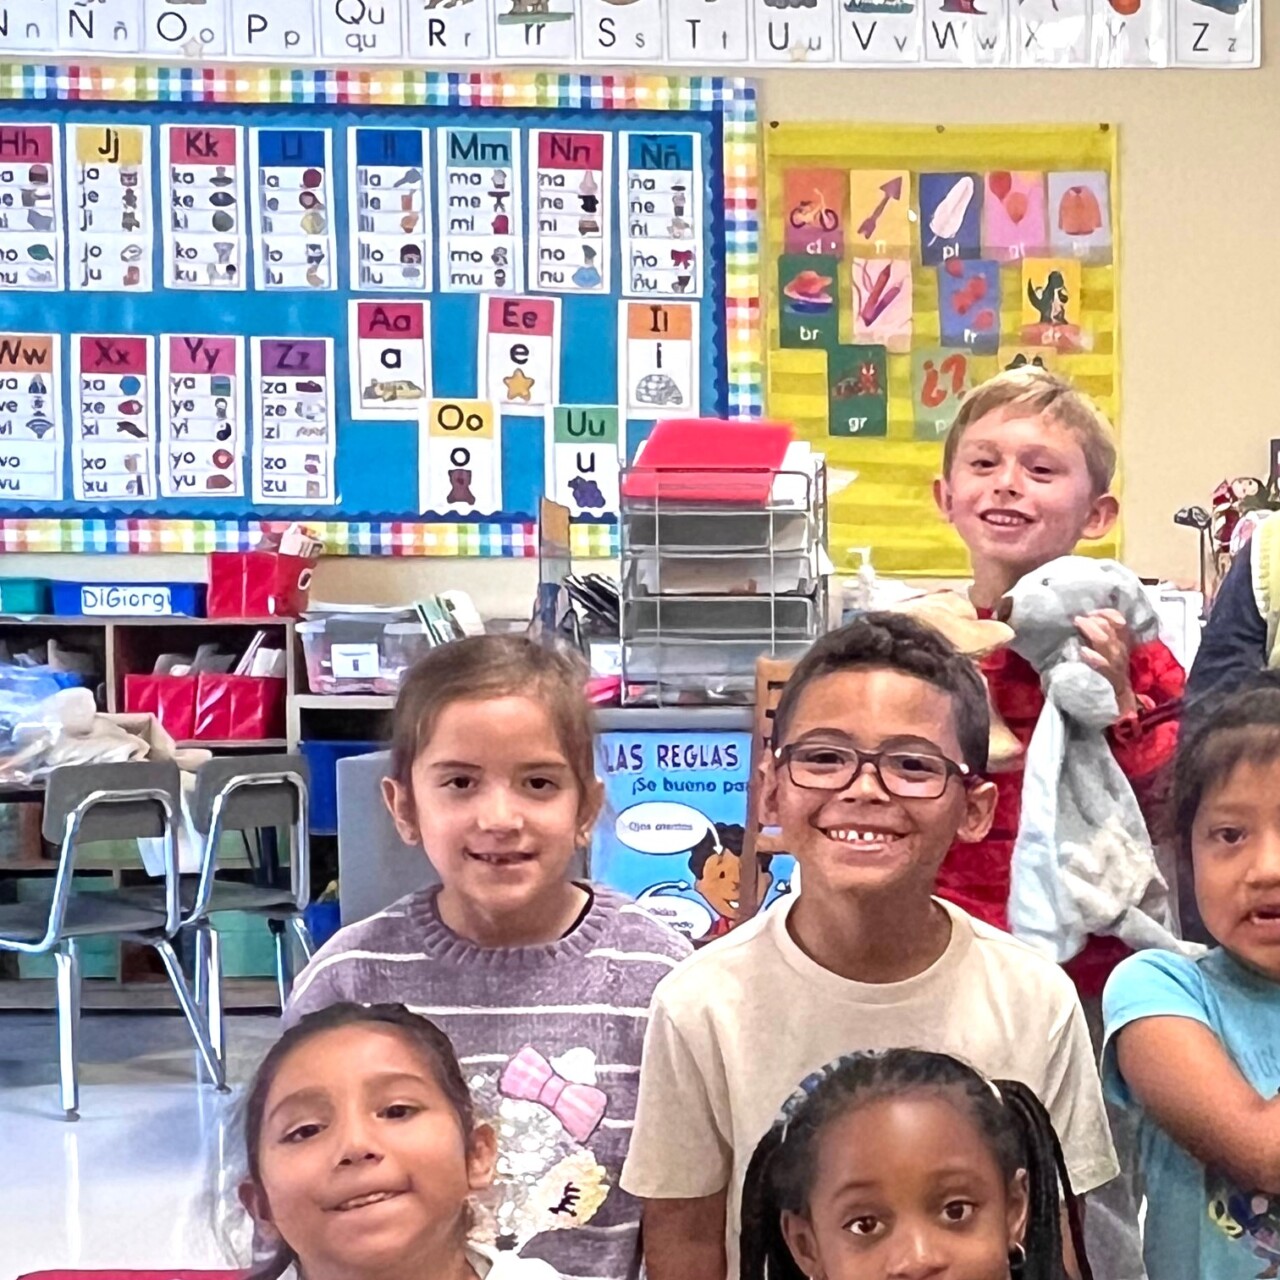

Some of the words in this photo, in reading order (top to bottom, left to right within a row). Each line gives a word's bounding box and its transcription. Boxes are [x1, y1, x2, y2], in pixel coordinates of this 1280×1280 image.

[69, 2, 93, 39] Ñ
[335, 0, 385, 25] Qu
[157, 12, 187, 41] O
[200, 28, 215, 43] o
[248, 14, 268, 43] P
[285, 31, 300, 48] p
[429, 19, 447, 47] R
[464, 33, 471, 47] r
[599, 18, 616, 47] S
[635, 33, 645, 48] s
[686, 20, 701, 48] T
[722, 32, 728, 49] t
[768, 22, 789, 49] U
[808, 36, 822, 51] u
[852, 22, 876, 50] V
[894, 36, 908, 52] v
[1192, 23, 1209, 51] Z
[1228, 37, 1237, 52] z
[345, 32, 376, 51] qu
[978, 35, 997, 50] w
[98, 129, 119, 163] Jj
[186, 131, 219, 157] Kk
[451, 132, 509, 161] Mm
[550, 134, 590, 162] Nn
[451, 215, 474, 231] mi
[81, 242, 102, 262] jo
[175, 242, 198, 259] ko
[451, 250, 482, 262] mo
[541, 248, 565, 261] no
[942, 242, 960, 260] pl
[81, 266, 102, 286] ju
[175, 264, 197, 282] ku
[451, 273, 482, 285] mu
[541, 270, 564, 283] nu
[370, 308, 411, 332] Aa
[503, 302, 538, 329] Ee
[800, 328, 820, 341] br
[95, 340, 129, 367] Xx
[184, 338, 219, 371] Yy
[277, 343, 309, 370] Zz
[381, 348, 402, 369] a
[510, 344, 529, 364] e
[263, 382, 287, 394] za
[438, 404, 484, 431] Oo
[567, 410, 605, 436] Uu
[849, 417, 868, 433] gr
[83, 458, 106, 470] xo
[171, 452, 195, 469] yo
[264, 457, 287, 470] zo
[451, 448, 470, 466] o
[577, 452, 595, 473] u
[84, 481, 107, 493] xu
[173, 475, 195, 491] yu
[264, 480, 287, 492] zu
[657, 744, 738, 768] REGLAS
[723, 780, 748, 795] pa
